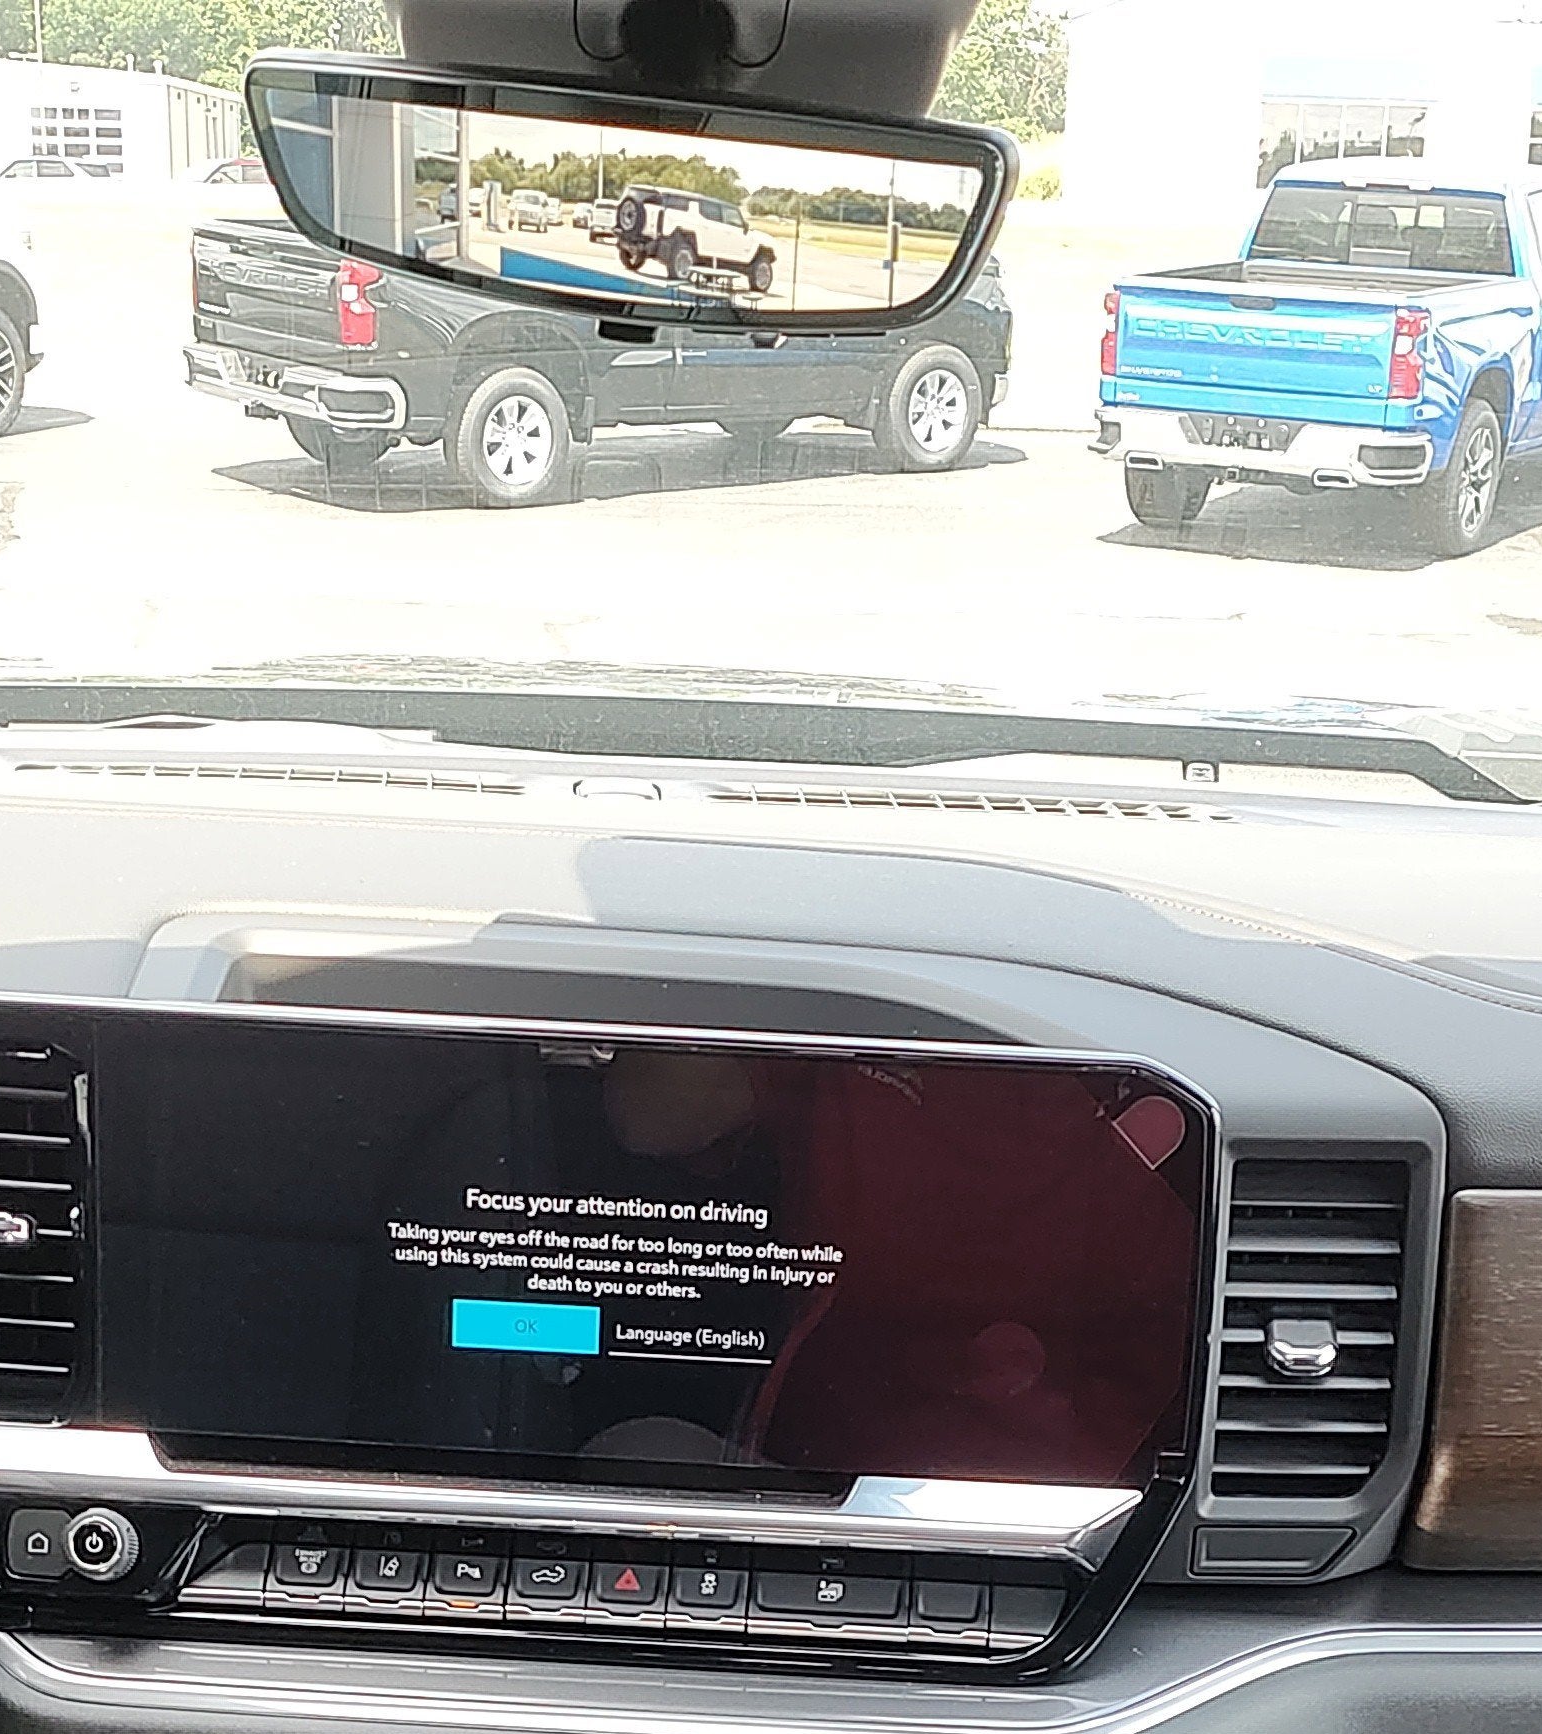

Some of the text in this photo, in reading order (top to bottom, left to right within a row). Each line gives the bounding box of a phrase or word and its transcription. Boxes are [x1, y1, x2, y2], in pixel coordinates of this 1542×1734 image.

[466, 1188, 768, 1229] Focus your attention on driving
[388, 1222, 843, 1262] Taking your eyes off the road for too long or too often while
[395, 1246, 835, 1286] using this system could cause a crash resulting in injury or
[527, 1273, 701, 1298] death to you or others.
[514, 1319, 539, 1334] OK
[616, 1324, 765, 1350] Language (English)
